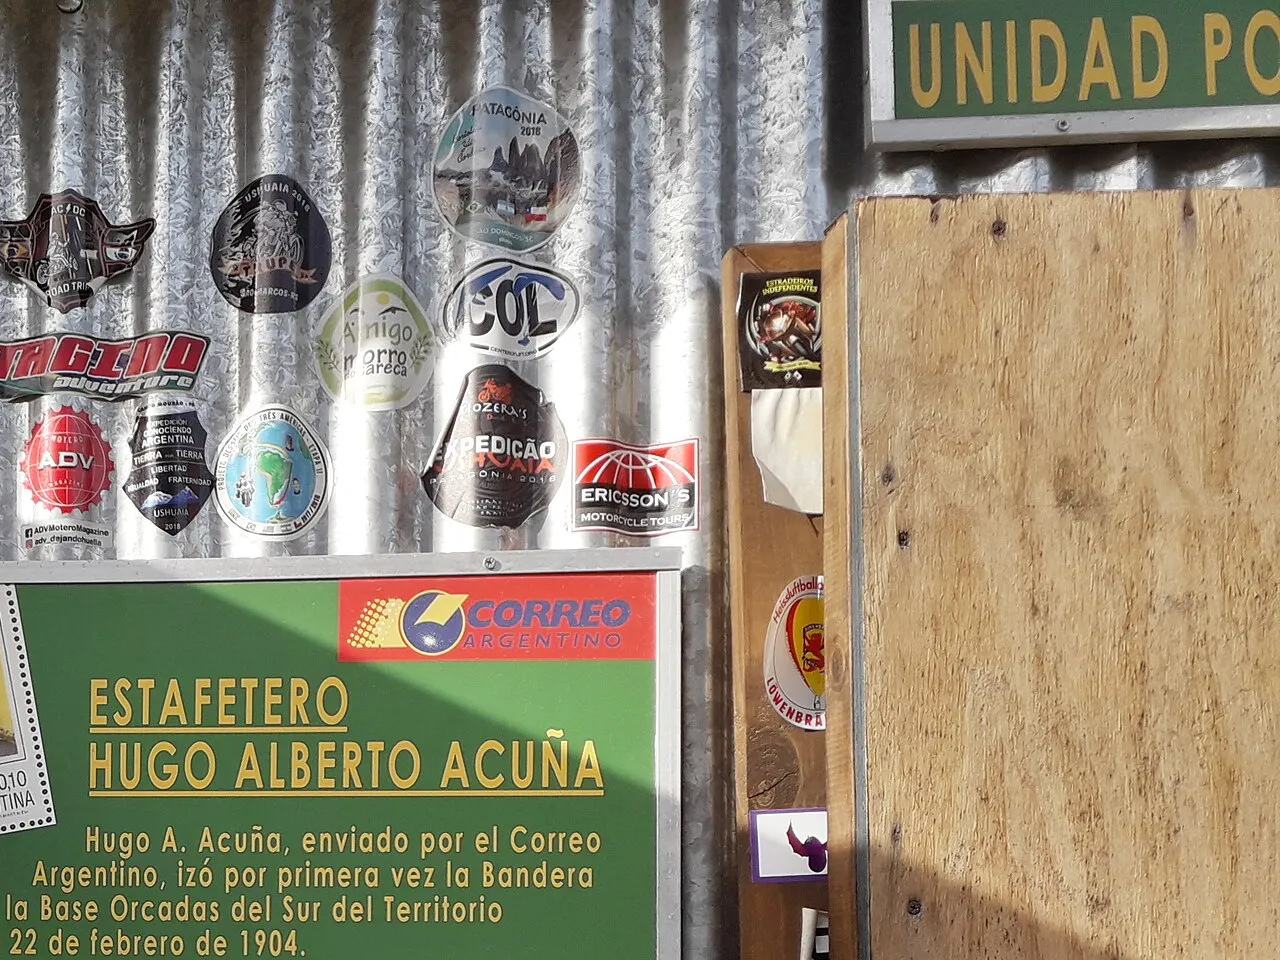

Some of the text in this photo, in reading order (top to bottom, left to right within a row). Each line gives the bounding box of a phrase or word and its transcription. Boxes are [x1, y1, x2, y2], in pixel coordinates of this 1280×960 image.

[908, 15, 1168, 109] UNIDAD
[52, 375, 194, 395] adventure
[38, 451, 95, 471] ADV
[581, 512, 691, 527] MOTORCYCLE TOURS
[462, 599, 630, 629] CORREO
[462, 632, 622, 650] ARGENTINO
[89, 676, 350, 727] ESTAFETERO
[89, 729, 605, 791] HUGO ALBERTO ACUÑA
[86, 825, 603, 860] Hugo A. Acuña, enviado por el Correo
[32, 857, 594, 894] Argentino, izó por primera vez la Bandera
[5, 893, 29, 921] la
[39, 893, 99, 922] Base
[109, 894, 220, 922] Orcadas
[231, 895, 272, 923] del
[282, 895, 322, 923] Sur
[332, 895, 373, 923] del
[383, 895, 504, 924] Territorio
[9, 928, 38, 955] 22
[48, 929, 81, 956] de
[89, 928, 185, 957] febrero
[196, 929, 228, 957] de
[240, 929, 307, 957] 1904.
